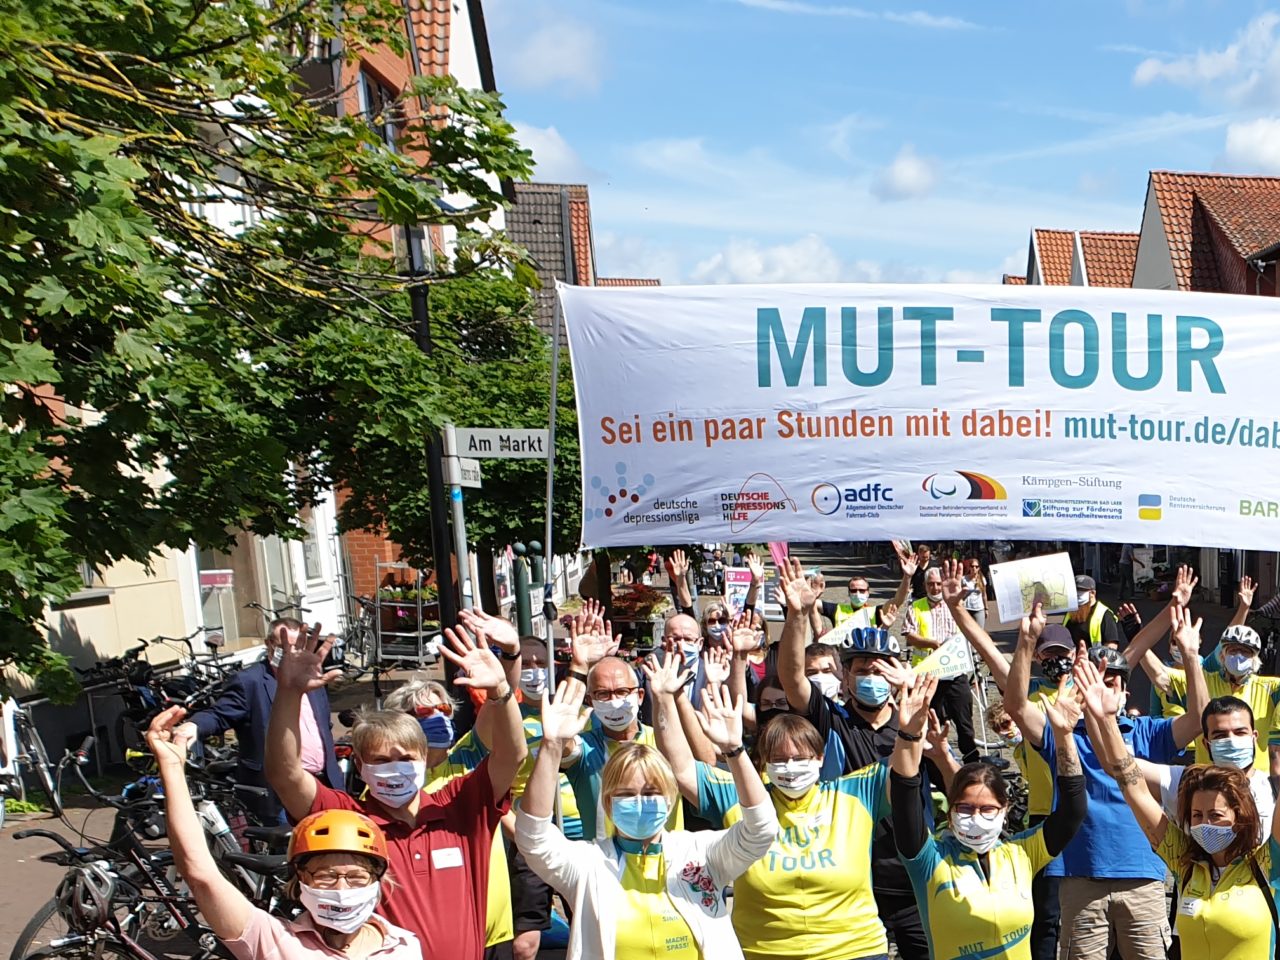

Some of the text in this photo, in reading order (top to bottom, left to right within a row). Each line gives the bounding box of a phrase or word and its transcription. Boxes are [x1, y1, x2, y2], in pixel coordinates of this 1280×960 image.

[756, 306, 1227, 394] MUT-TOUR
[601, 414, 641, 446] Sei
[653, 411, 694, 443] ein
[704, 414, 767, 448] paar
[778, 410, 894, 439] Stunden
[906, 408, 951, 438] mit
[962, 408, 1052, 438] dabei!
[468, 434, 543, 452] Am Markt
[1022, 475, 1122, 490] Kämpgen-Stiftung
[721, 492, 769, 501] DEUTSCHE
[844, 483, 893, 502] adfc
[1169, 495, 1196, 503] Deutsche
[653, 498, 698, 510] deutsche
[722, 502, 786, 511] DEPRESSIONS
[1042, 504, 1069, 512] Stiftung
[1086, 505, 1122, 514] Förderung
[623, 510, 700, 525] depressionsliga
[723, 512, 748, 521] HILFE
[768, 848, 837, 872] TOUR
[665, 935, 688, 944] MACHT
[958, 924, 1031, 957] MUT TOUR
[666, 942, 689, 951] SPASS!
